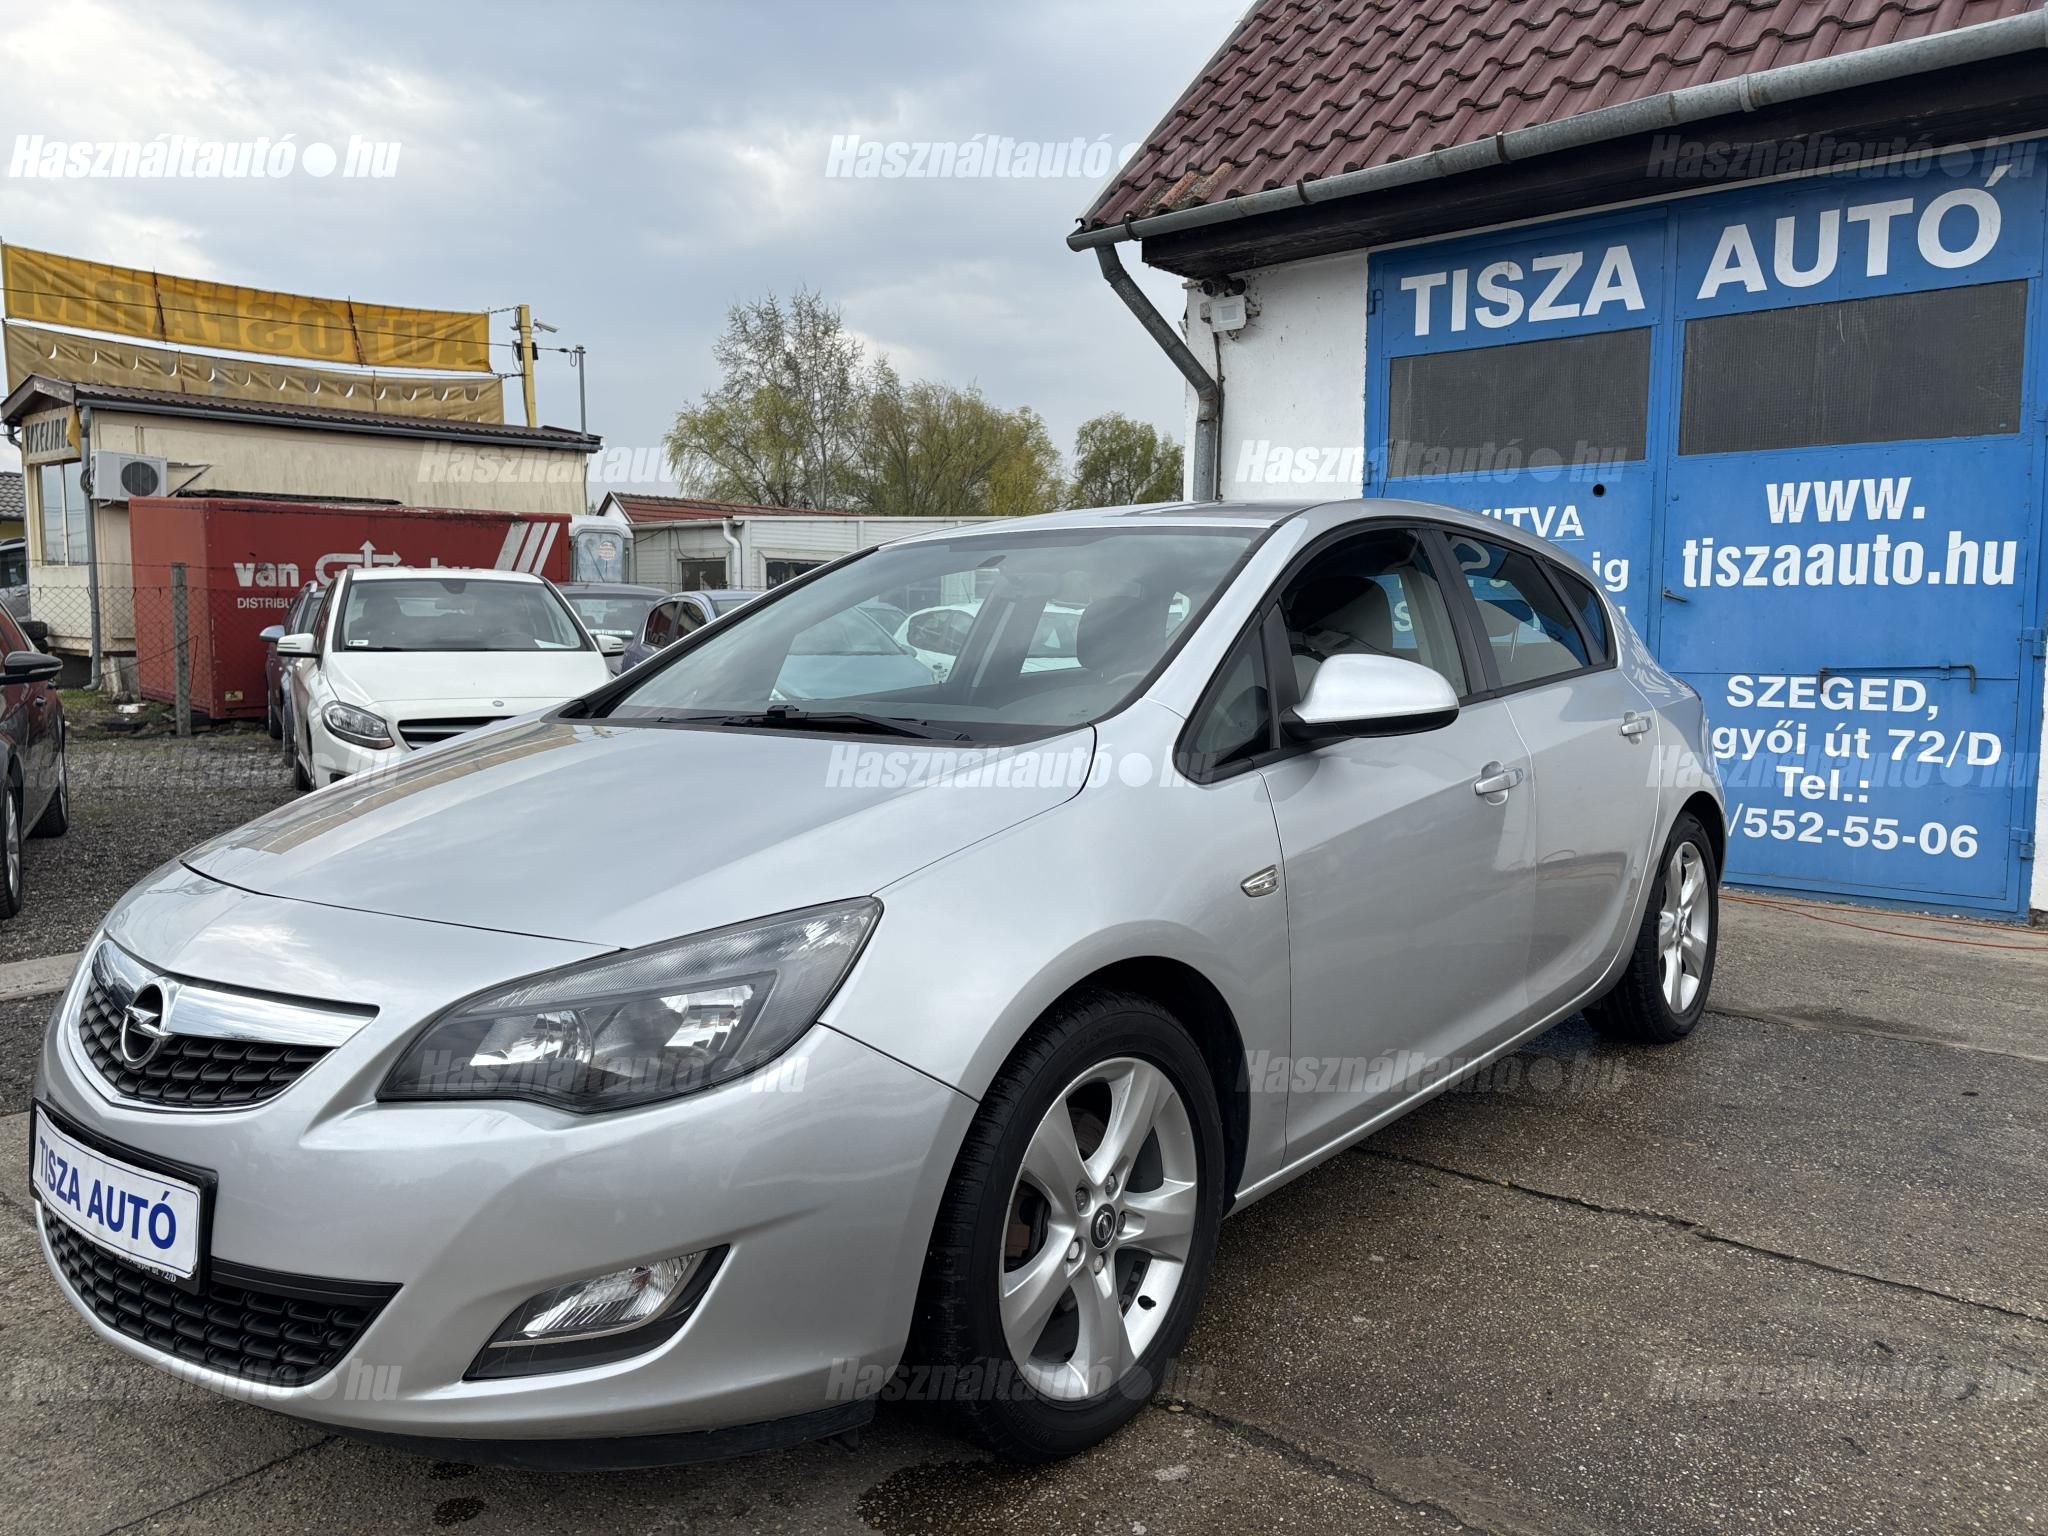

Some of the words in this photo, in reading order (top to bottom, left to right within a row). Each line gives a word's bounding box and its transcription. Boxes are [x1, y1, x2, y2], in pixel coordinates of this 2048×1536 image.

[1401, 245, 1645, 337] TISZA
[1697, 164, 2013, 301] AUTÓ
[1766, 477, 1926, 525] www.
[233, 561, 299, 587] van
[1683, 531, 2018, 588] tiszaauto.hu
[1727, 675, 1939, 721] SZEGED,
[1824, 722, 1872, 760] út
[1888, 729, 2002, 768] 72/D
[1776, 765, 1869, 803] Tel.:
[39, 1136, 81, 1212] TISZA
[86, 1178, 177, 1250] AUTÓ
